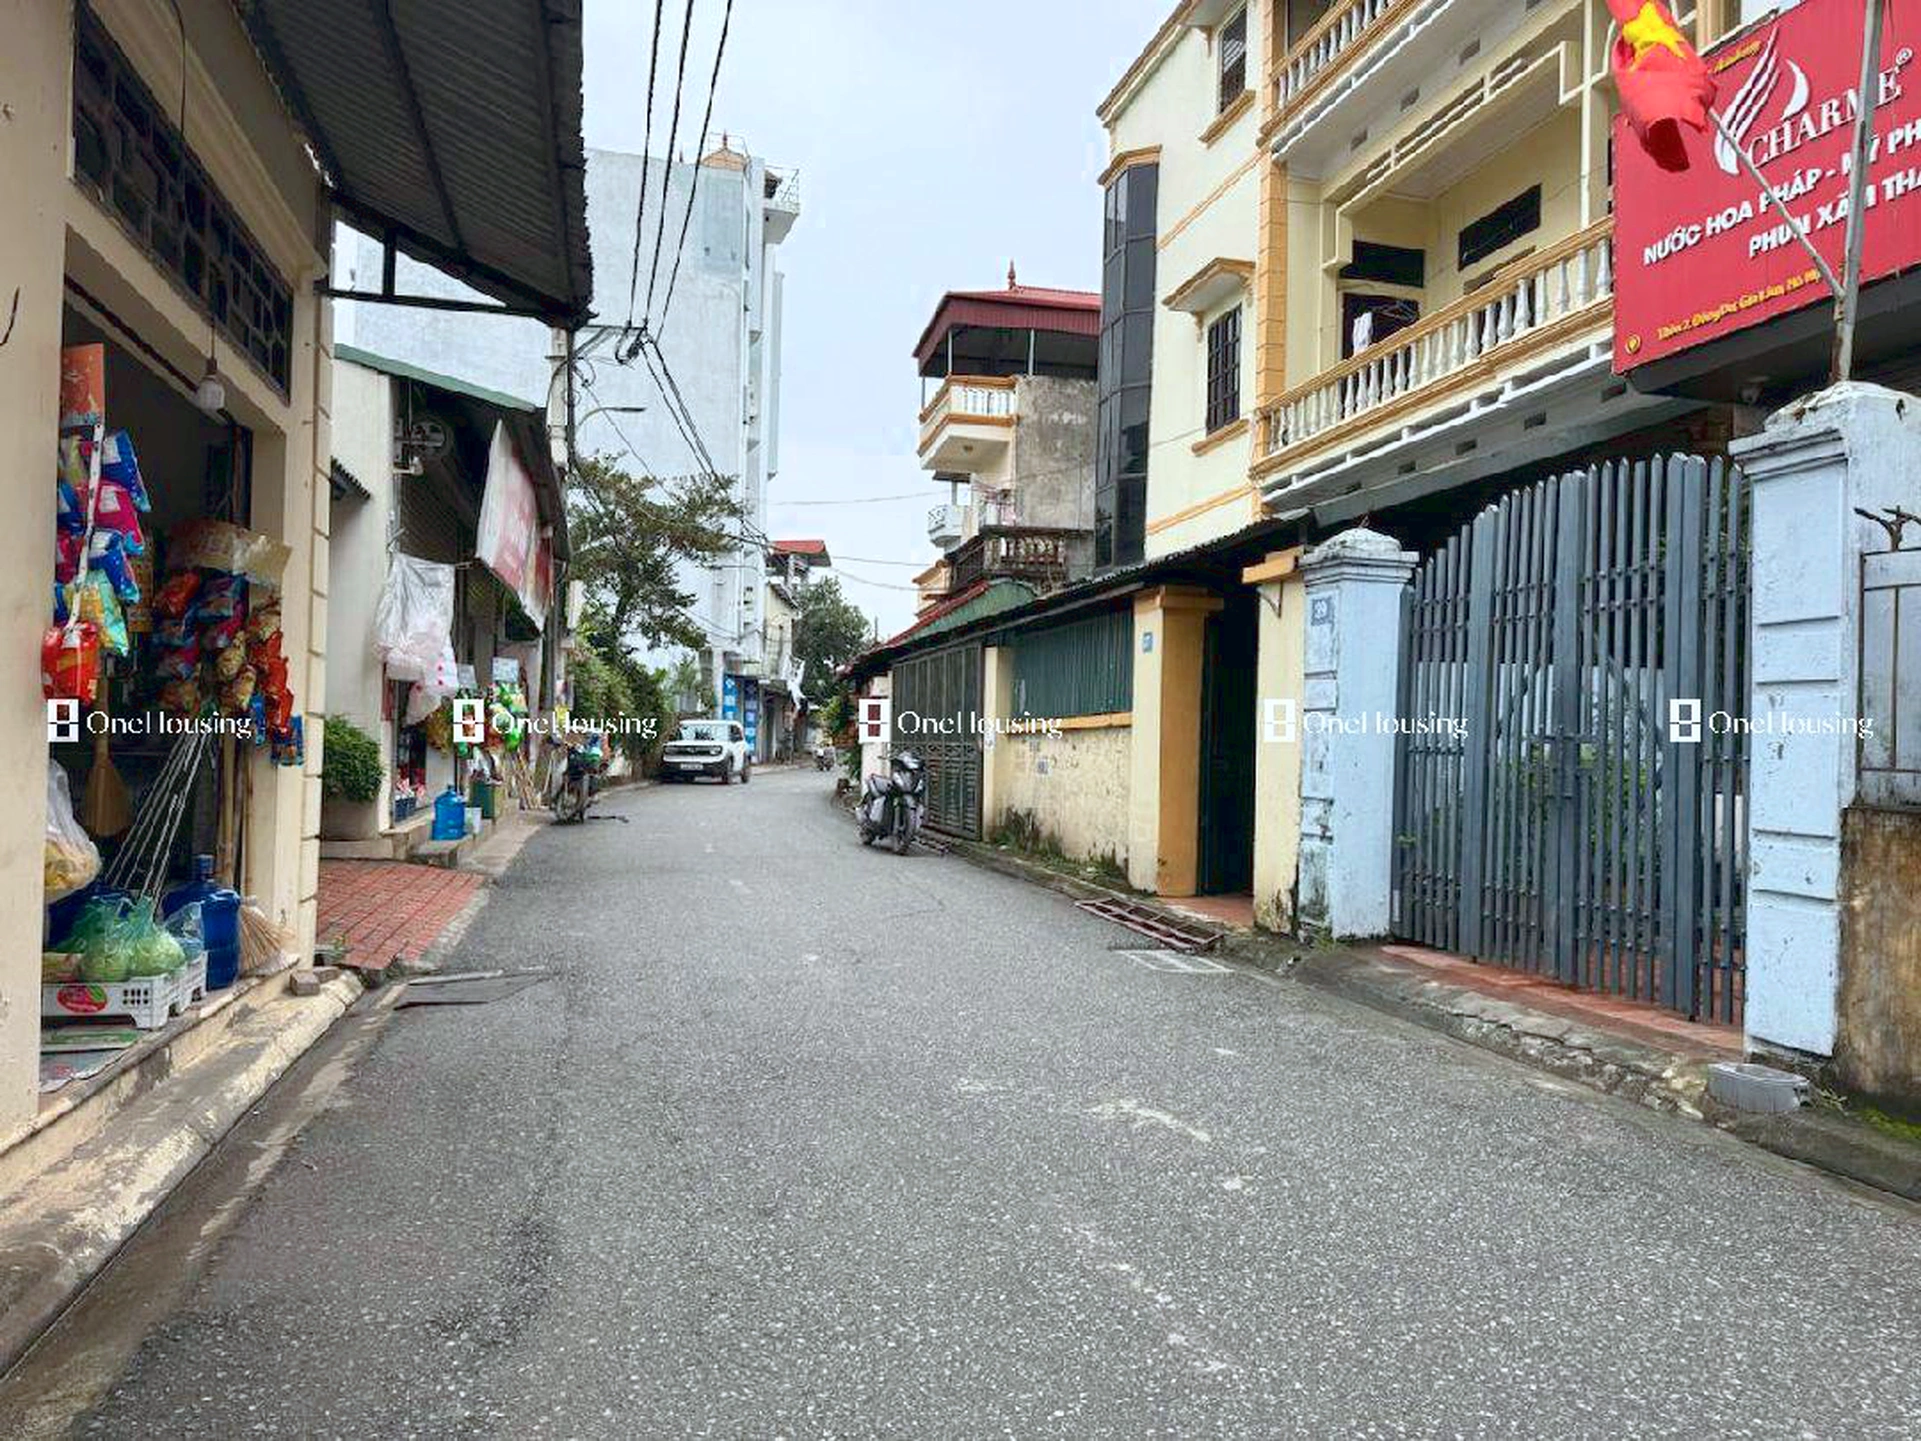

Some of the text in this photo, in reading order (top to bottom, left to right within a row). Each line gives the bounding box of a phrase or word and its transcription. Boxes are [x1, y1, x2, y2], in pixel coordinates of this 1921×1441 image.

[1643, 224, 1703, 265] NƯỚC
[1705, 200, 1753, 237] HOA
[1759, 167, 1822, 213] PHÁP
[1749, 214, 1811, 257] PHUN
